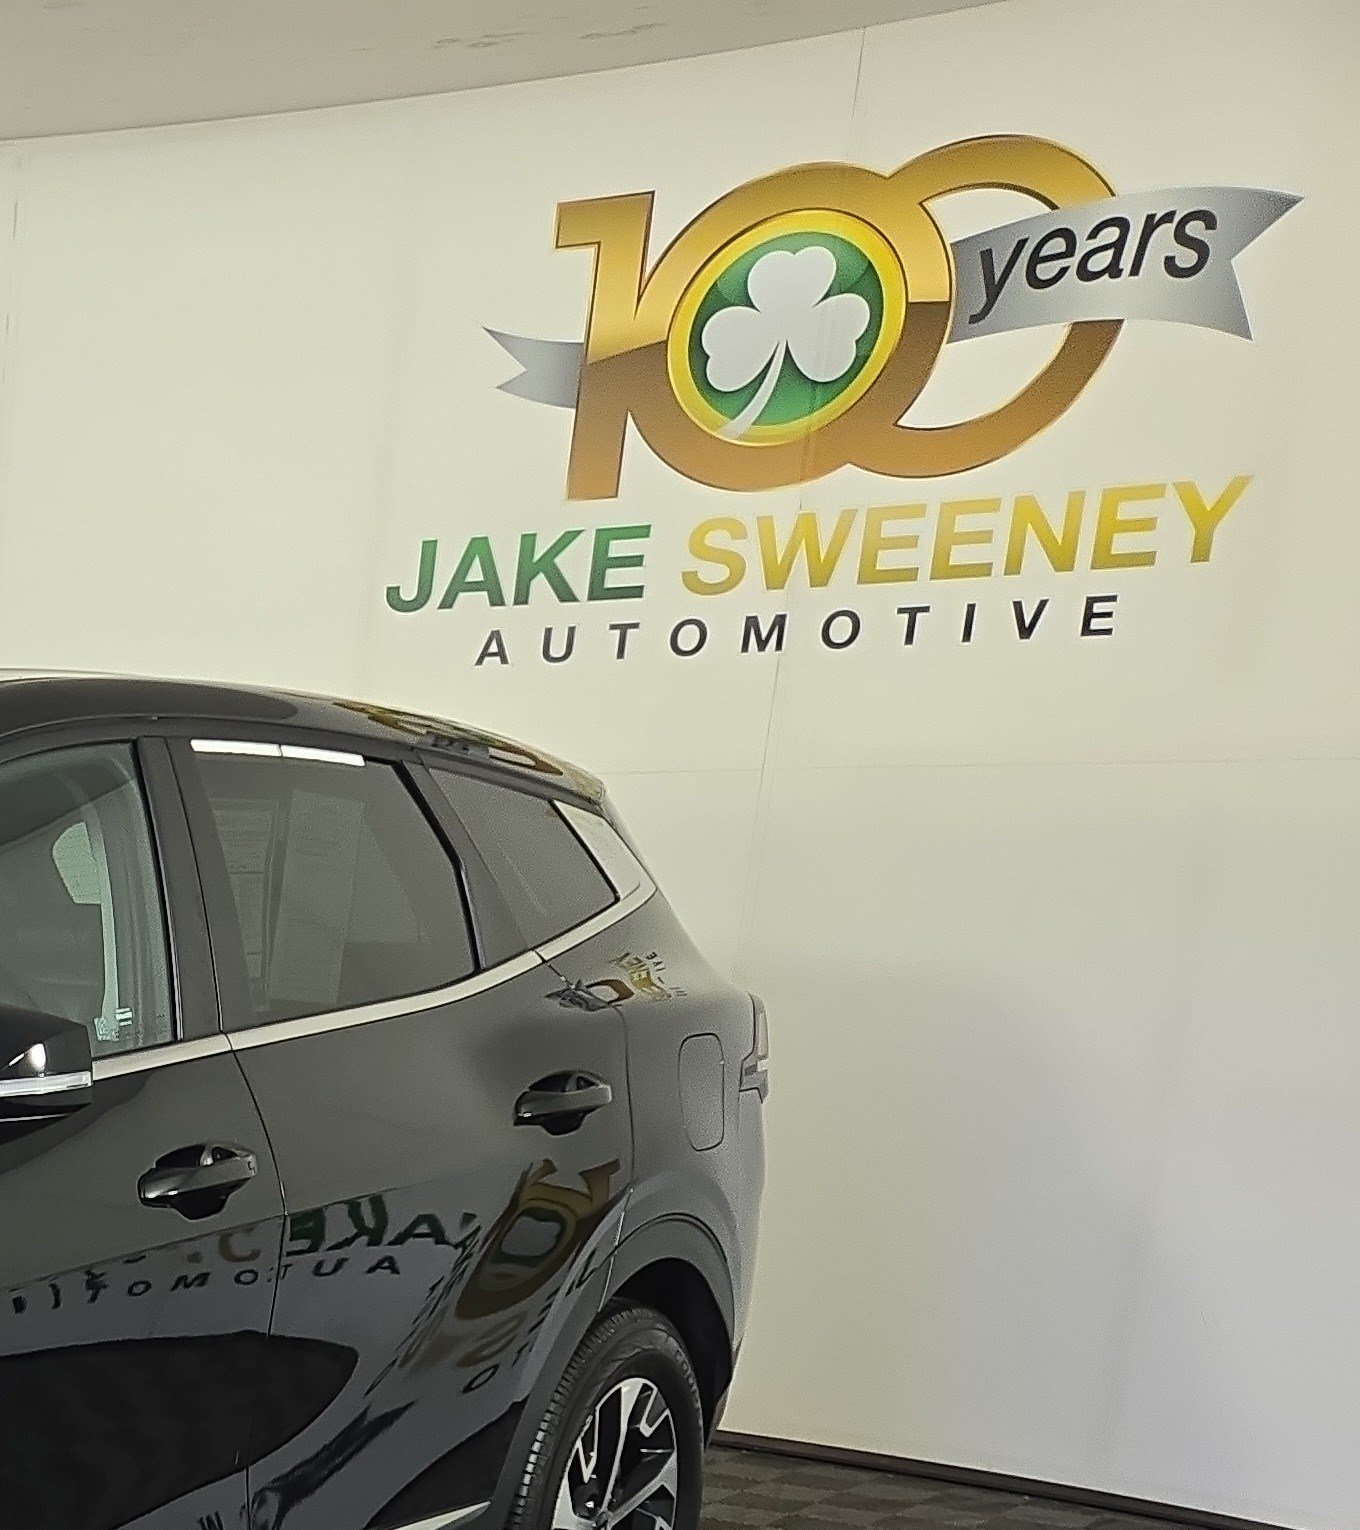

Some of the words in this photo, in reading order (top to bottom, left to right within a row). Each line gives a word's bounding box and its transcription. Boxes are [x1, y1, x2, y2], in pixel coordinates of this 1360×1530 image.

[553, 133, 1125, 502] 100
[967, 207, 1219, 326] years
[385, 523, 652, 614] JAKE
[680, 474, 1254, 597] SWEENEY
[474, 593, 1120, 667] AUTOMOTIVE
